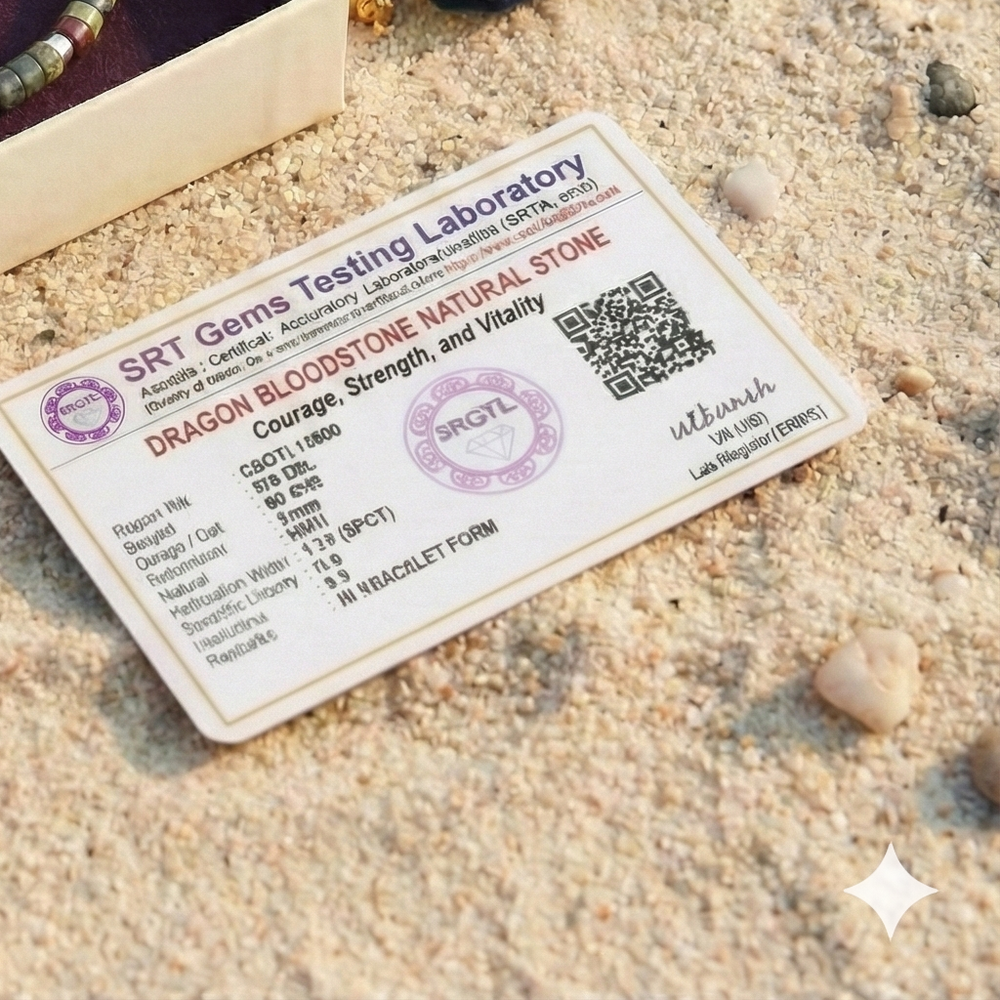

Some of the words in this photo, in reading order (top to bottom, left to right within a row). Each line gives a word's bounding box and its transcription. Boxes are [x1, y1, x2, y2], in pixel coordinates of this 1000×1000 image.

[119, 336, 185, 382] SRT
[195, 296, 290, 346] Gems
[289, 236, 415, 300] Testing
[413, 154, 584, 244] Laboratory
[144, 394, 254, 457] DRAGON
[253, 317, 418, 406] BLOODSTONE
[416, 267, 532, 329] NATURAL
[529, 226, 610, 275] STONE
[253, 393, 343, 439] Courage,
[344, 347, 436, 396] Strength,
[439, 323, 476, 353] and
[475, 293, 544, 333] Vitality
[446, 519, 498, 553] FORM
